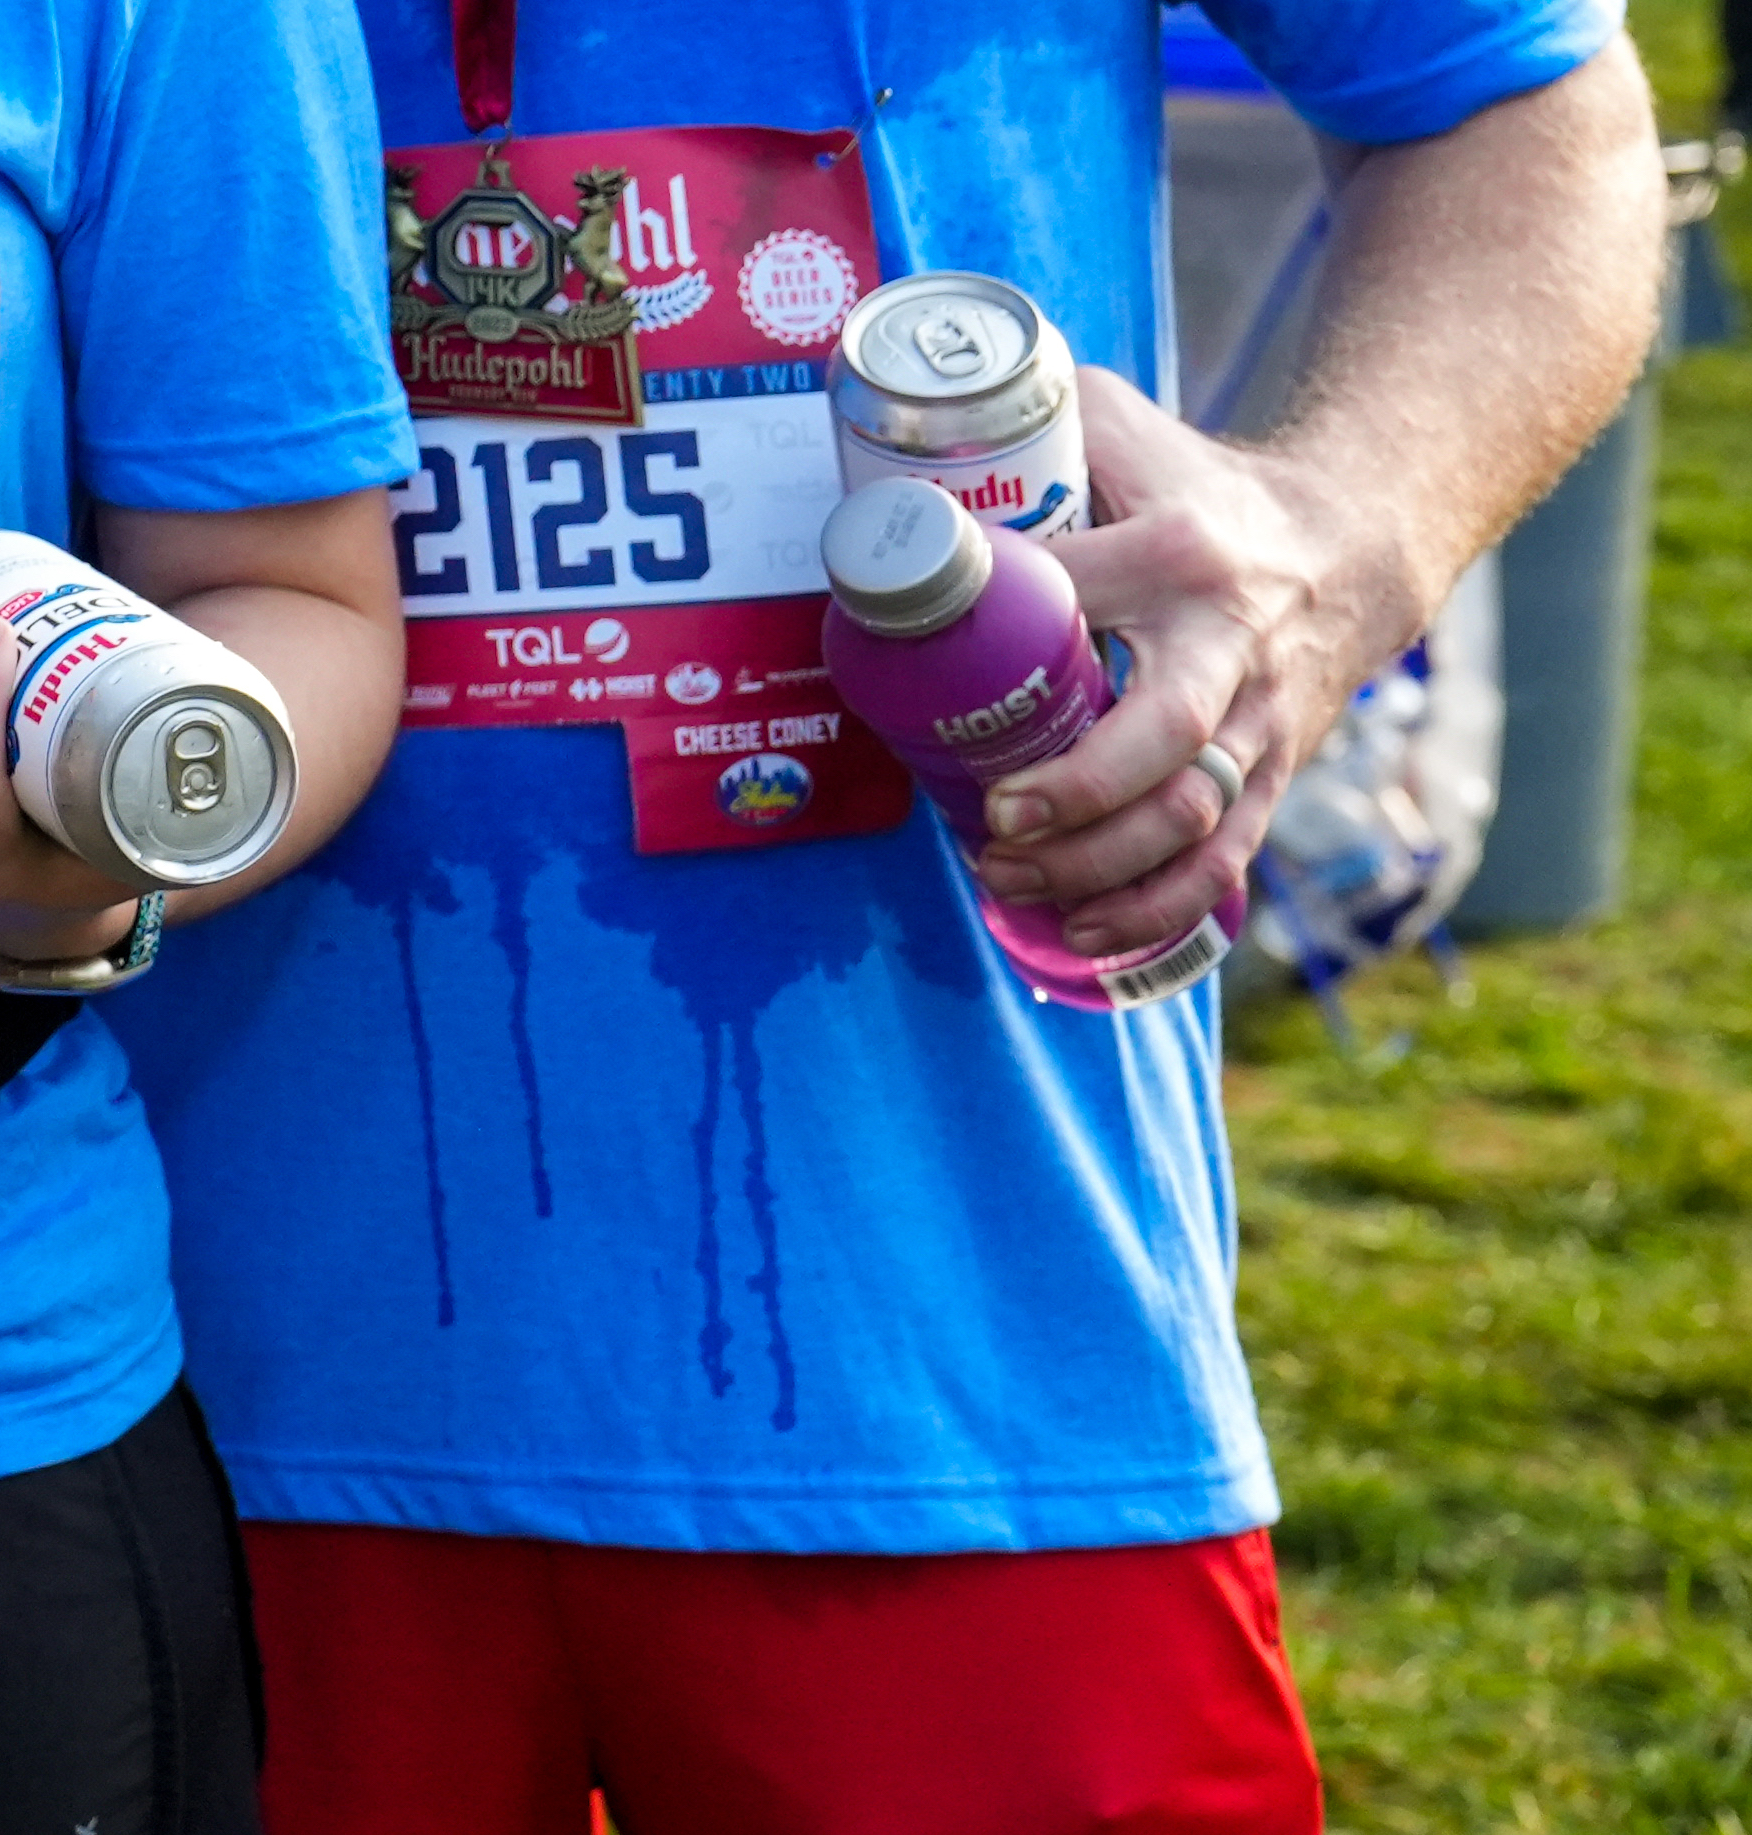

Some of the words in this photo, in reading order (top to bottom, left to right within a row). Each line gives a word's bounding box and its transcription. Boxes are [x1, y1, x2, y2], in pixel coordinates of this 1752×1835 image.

[764, 289, 833, 309] SERIES
[771, 270, 820, 288] BEER
[403, 334, 588, 398] Hudepohl
[746, 362, 812, 392] TWO
[400, 432, 712, 598] 2125
[485, 626, 583, 668] TQL
[24, 633, 128, 724] Hudy
[933, 666, 1053, 746] HOIST
[674, 721, 763, 756] CHEESE
[767, 713, 842, 749] CONEY
